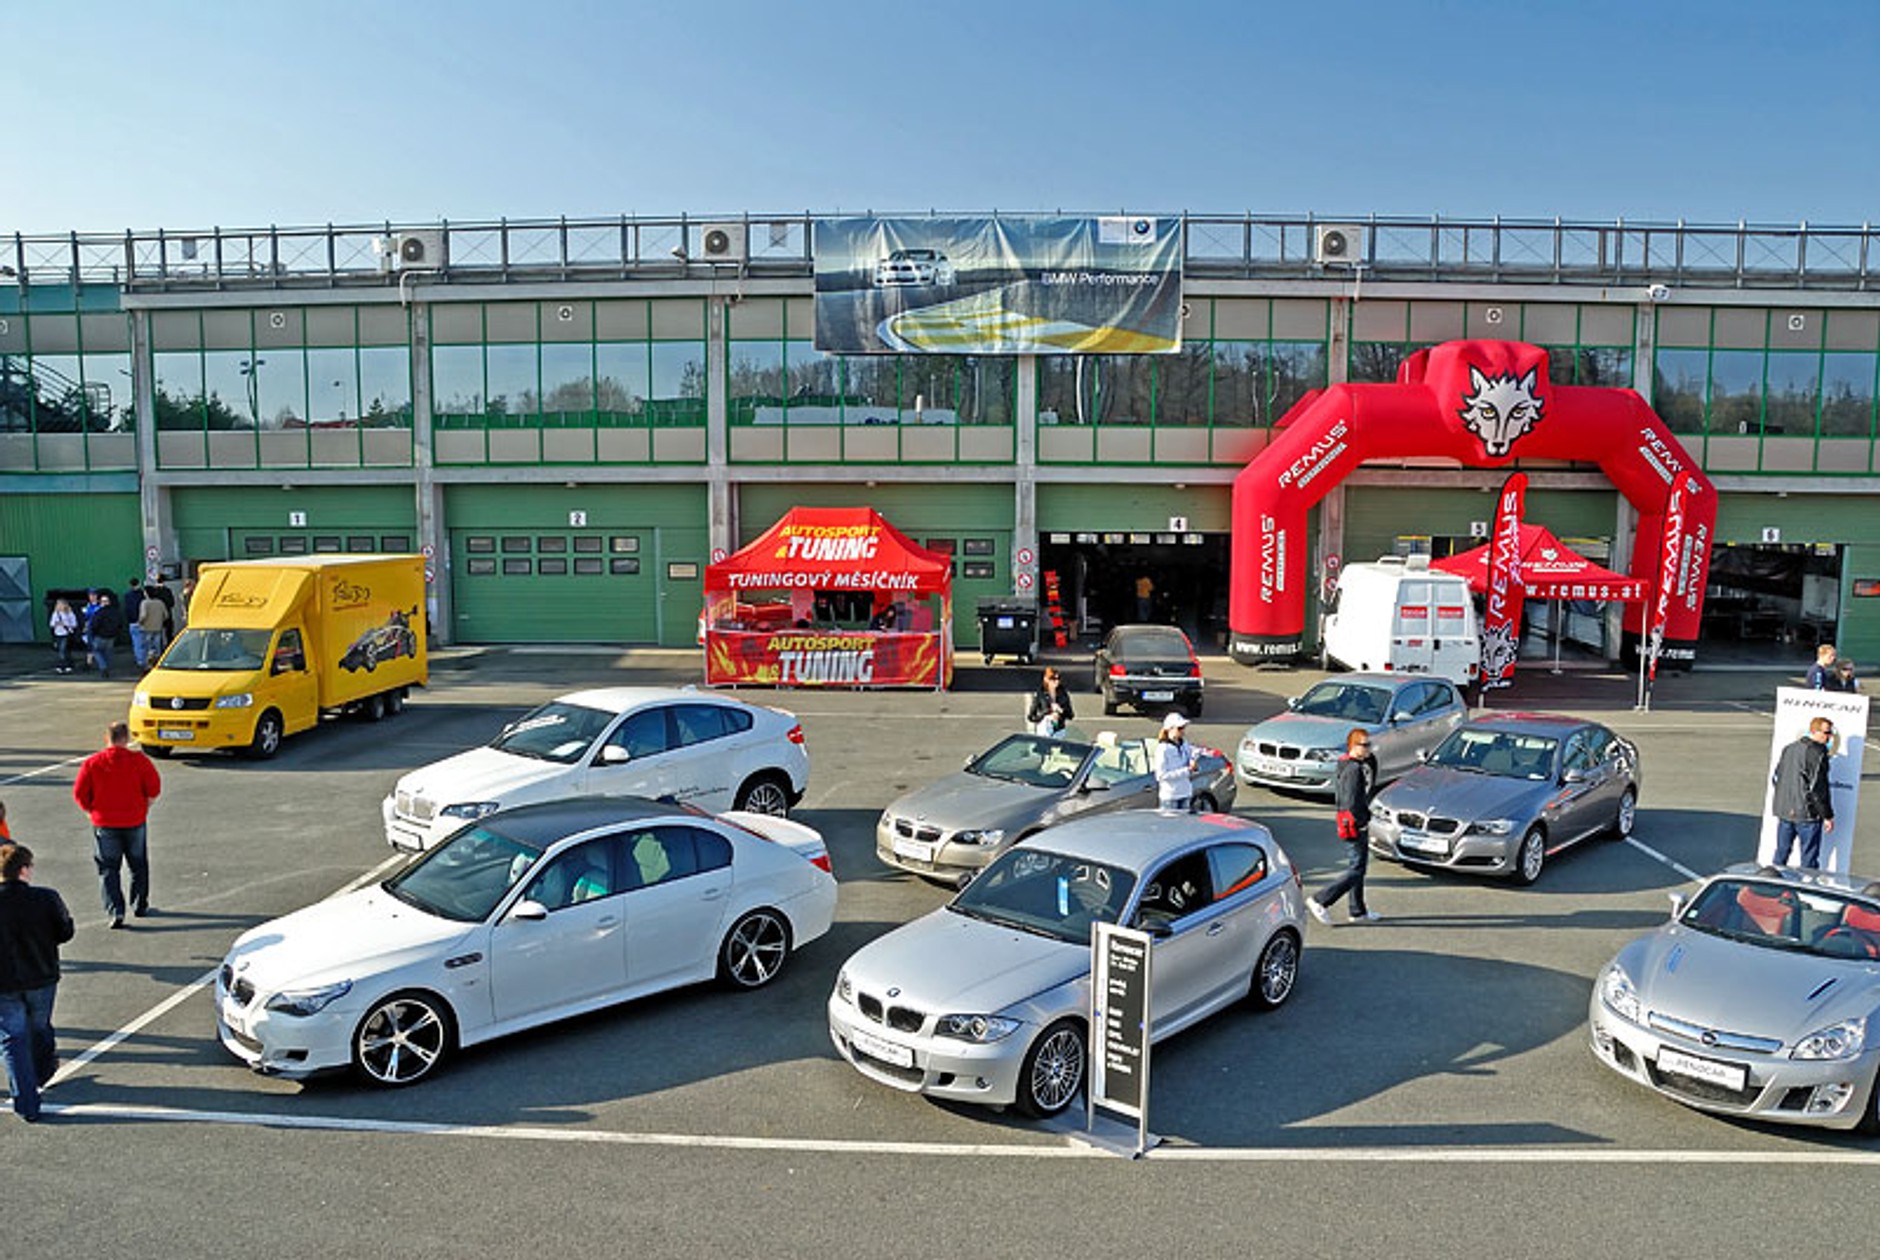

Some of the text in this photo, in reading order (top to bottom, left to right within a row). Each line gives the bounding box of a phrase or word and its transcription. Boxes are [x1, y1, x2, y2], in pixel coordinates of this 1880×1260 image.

[1041, 271, 1160, 286] BMW Performance
[1277, 418, 1350, 490] REMUS
[1640, 426, 1703, 495] REMS
[778, 525, 882, 538] AUTOSPORT
[787, 535, 880, 561] TUNING
[1260, 514, 1275, 603] REMUS
[1490, 491, 1518, 619] REMUS
[728, 569, 919, 589] TUNINGOVÝ MĚSÍČNÍK
[1686, 523, 1708, 612] REMUS
[767, 636, 877, 651] AUTOSPORT
[778, 650, 874, 682] TUNING
